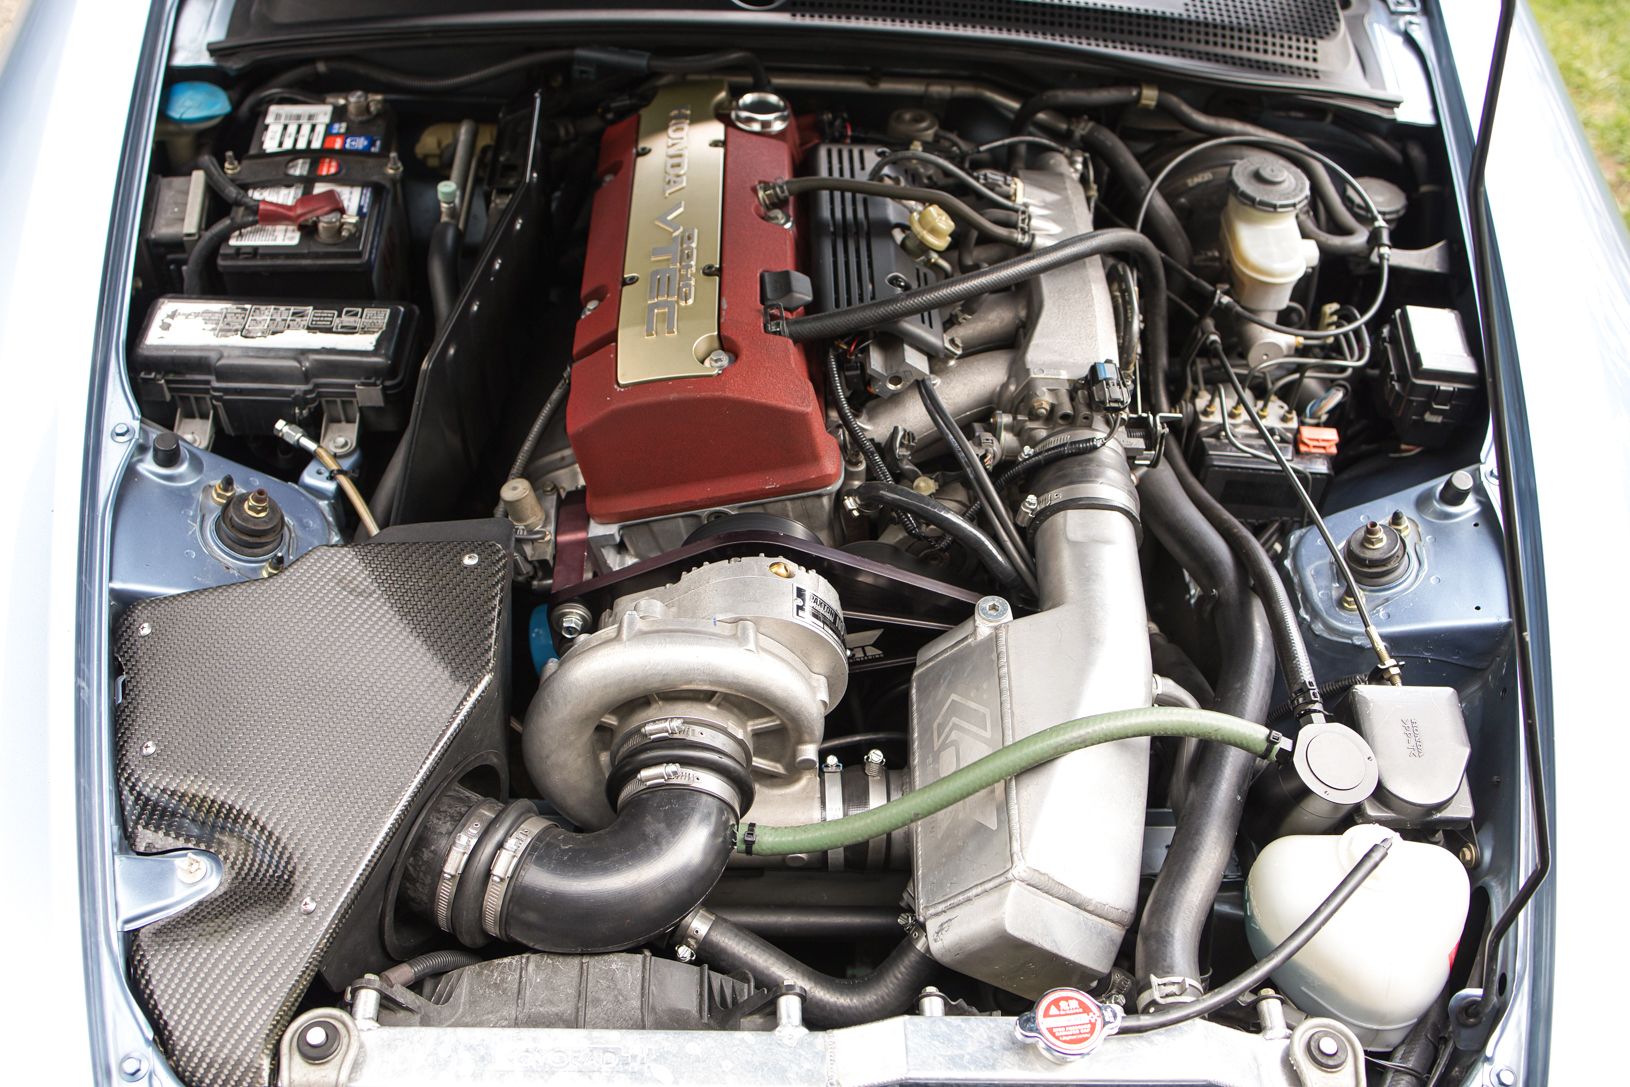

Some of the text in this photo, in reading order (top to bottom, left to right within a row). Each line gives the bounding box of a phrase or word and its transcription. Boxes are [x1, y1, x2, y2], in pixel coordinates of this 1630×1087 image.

[664, 104, 691, 198] HONDA
[644, 200, 685, 339] VTEC
[679, 227, 698, 306] DOHC
[809, 593, 835, 621] PAXTON
[1410, 718, 1424, 759] HONDA
